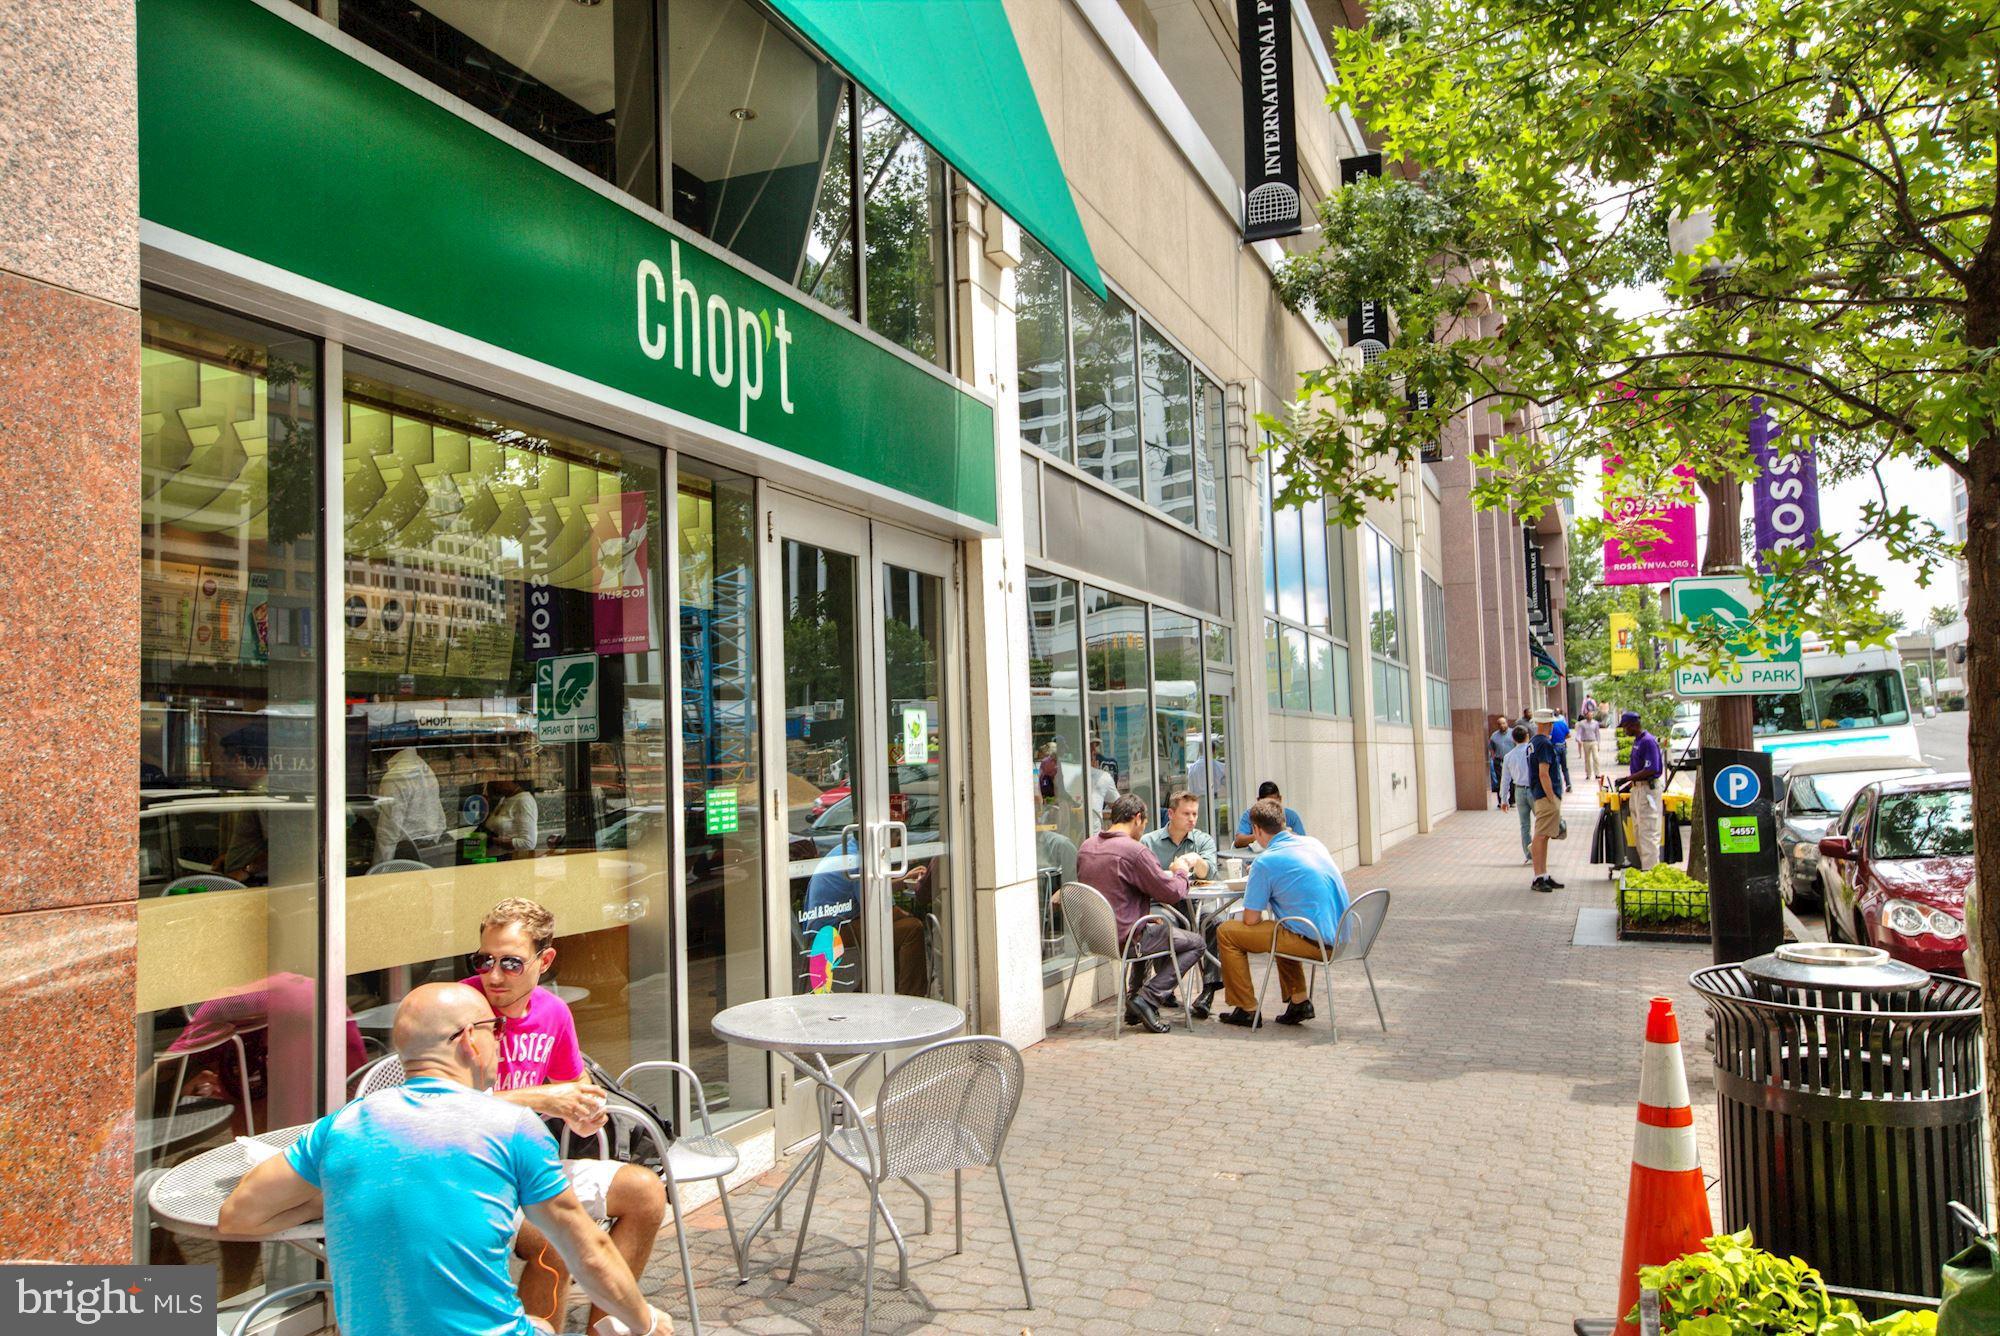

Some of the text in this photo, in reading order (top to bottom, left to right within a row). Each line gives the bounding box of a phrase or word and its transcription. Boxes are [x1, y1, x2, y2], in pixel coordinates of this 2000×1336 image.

[1258, 17, 1282, 177] INTERNATIONAL
[637, 238, 794, 434] chop't
[1613, 559, 1690, 572] ROSSLYNVA.ORG
[1752, 669, 1796, 682] PARK
[419, 716, 453, 728] CHOPT
[1729, 772, 1749, 801] P
[1730, 826, 1756, 836] 54557
[798, 899, 853, 922] Local & Regional
[498, 1032, 555, 1063] LISTER
